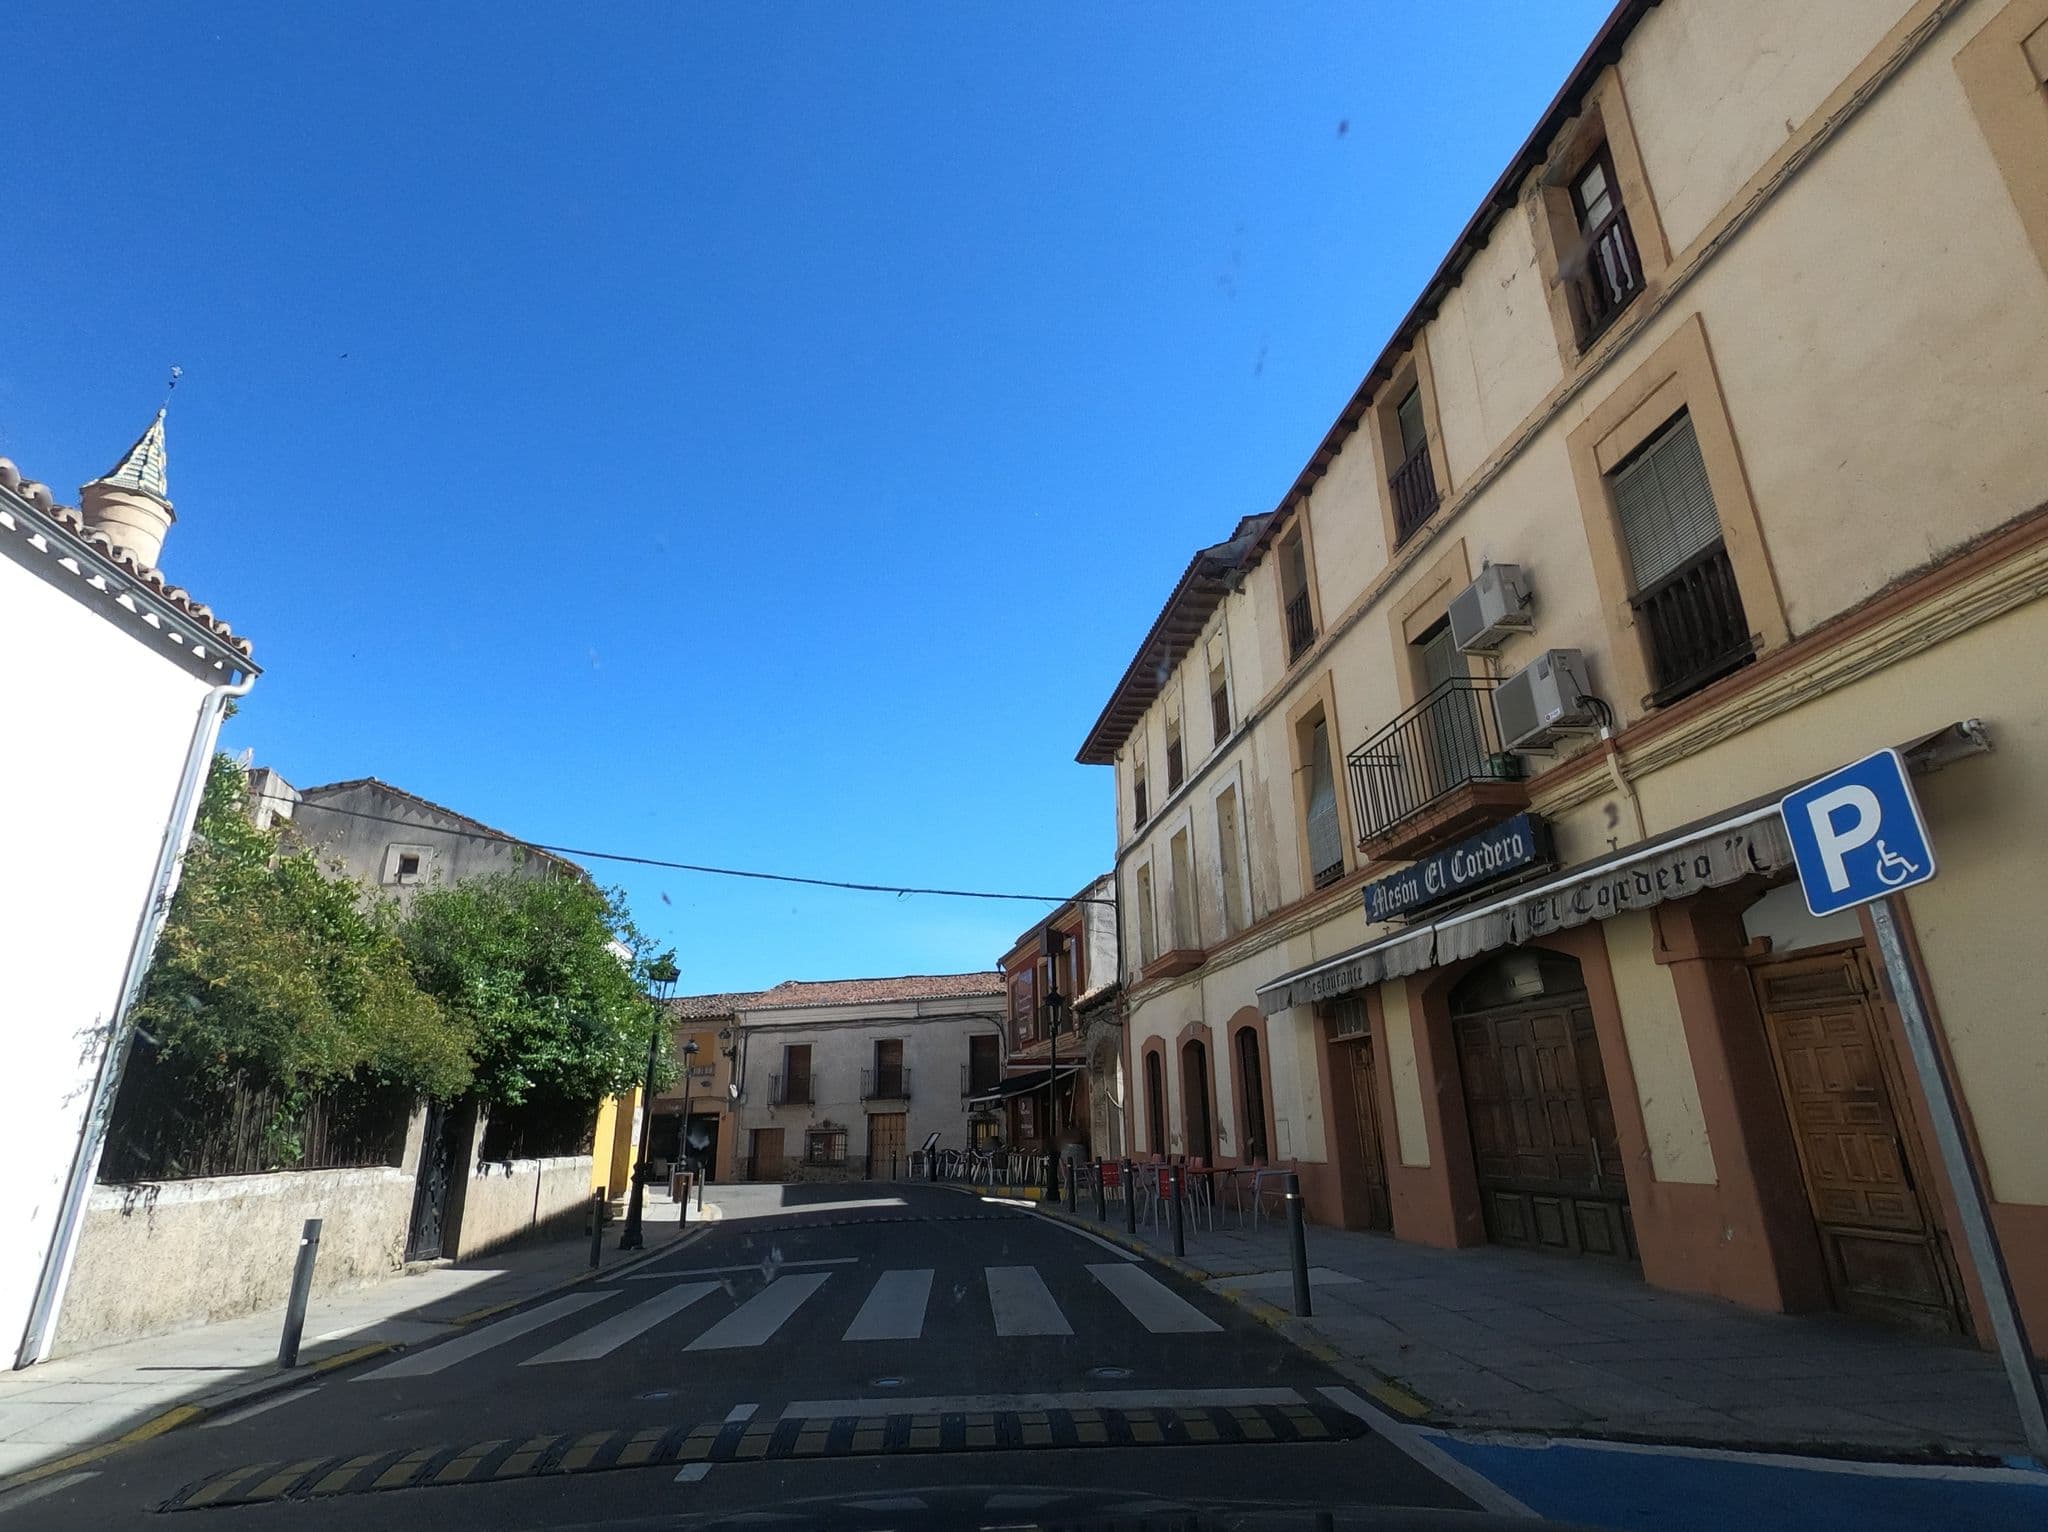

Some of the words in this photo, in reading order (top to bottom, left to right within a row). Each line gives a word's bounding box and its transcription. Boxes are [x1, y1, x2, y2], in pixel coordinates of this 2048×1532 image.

[1373, 874, 1419, 917] Mesón
[1424, 858, 1447, 894] El
[1451, 833, 1524, 883] Cordero
[1806, 784, 1882, 893] P
[1304, 967, 1363, 995] estaurante
